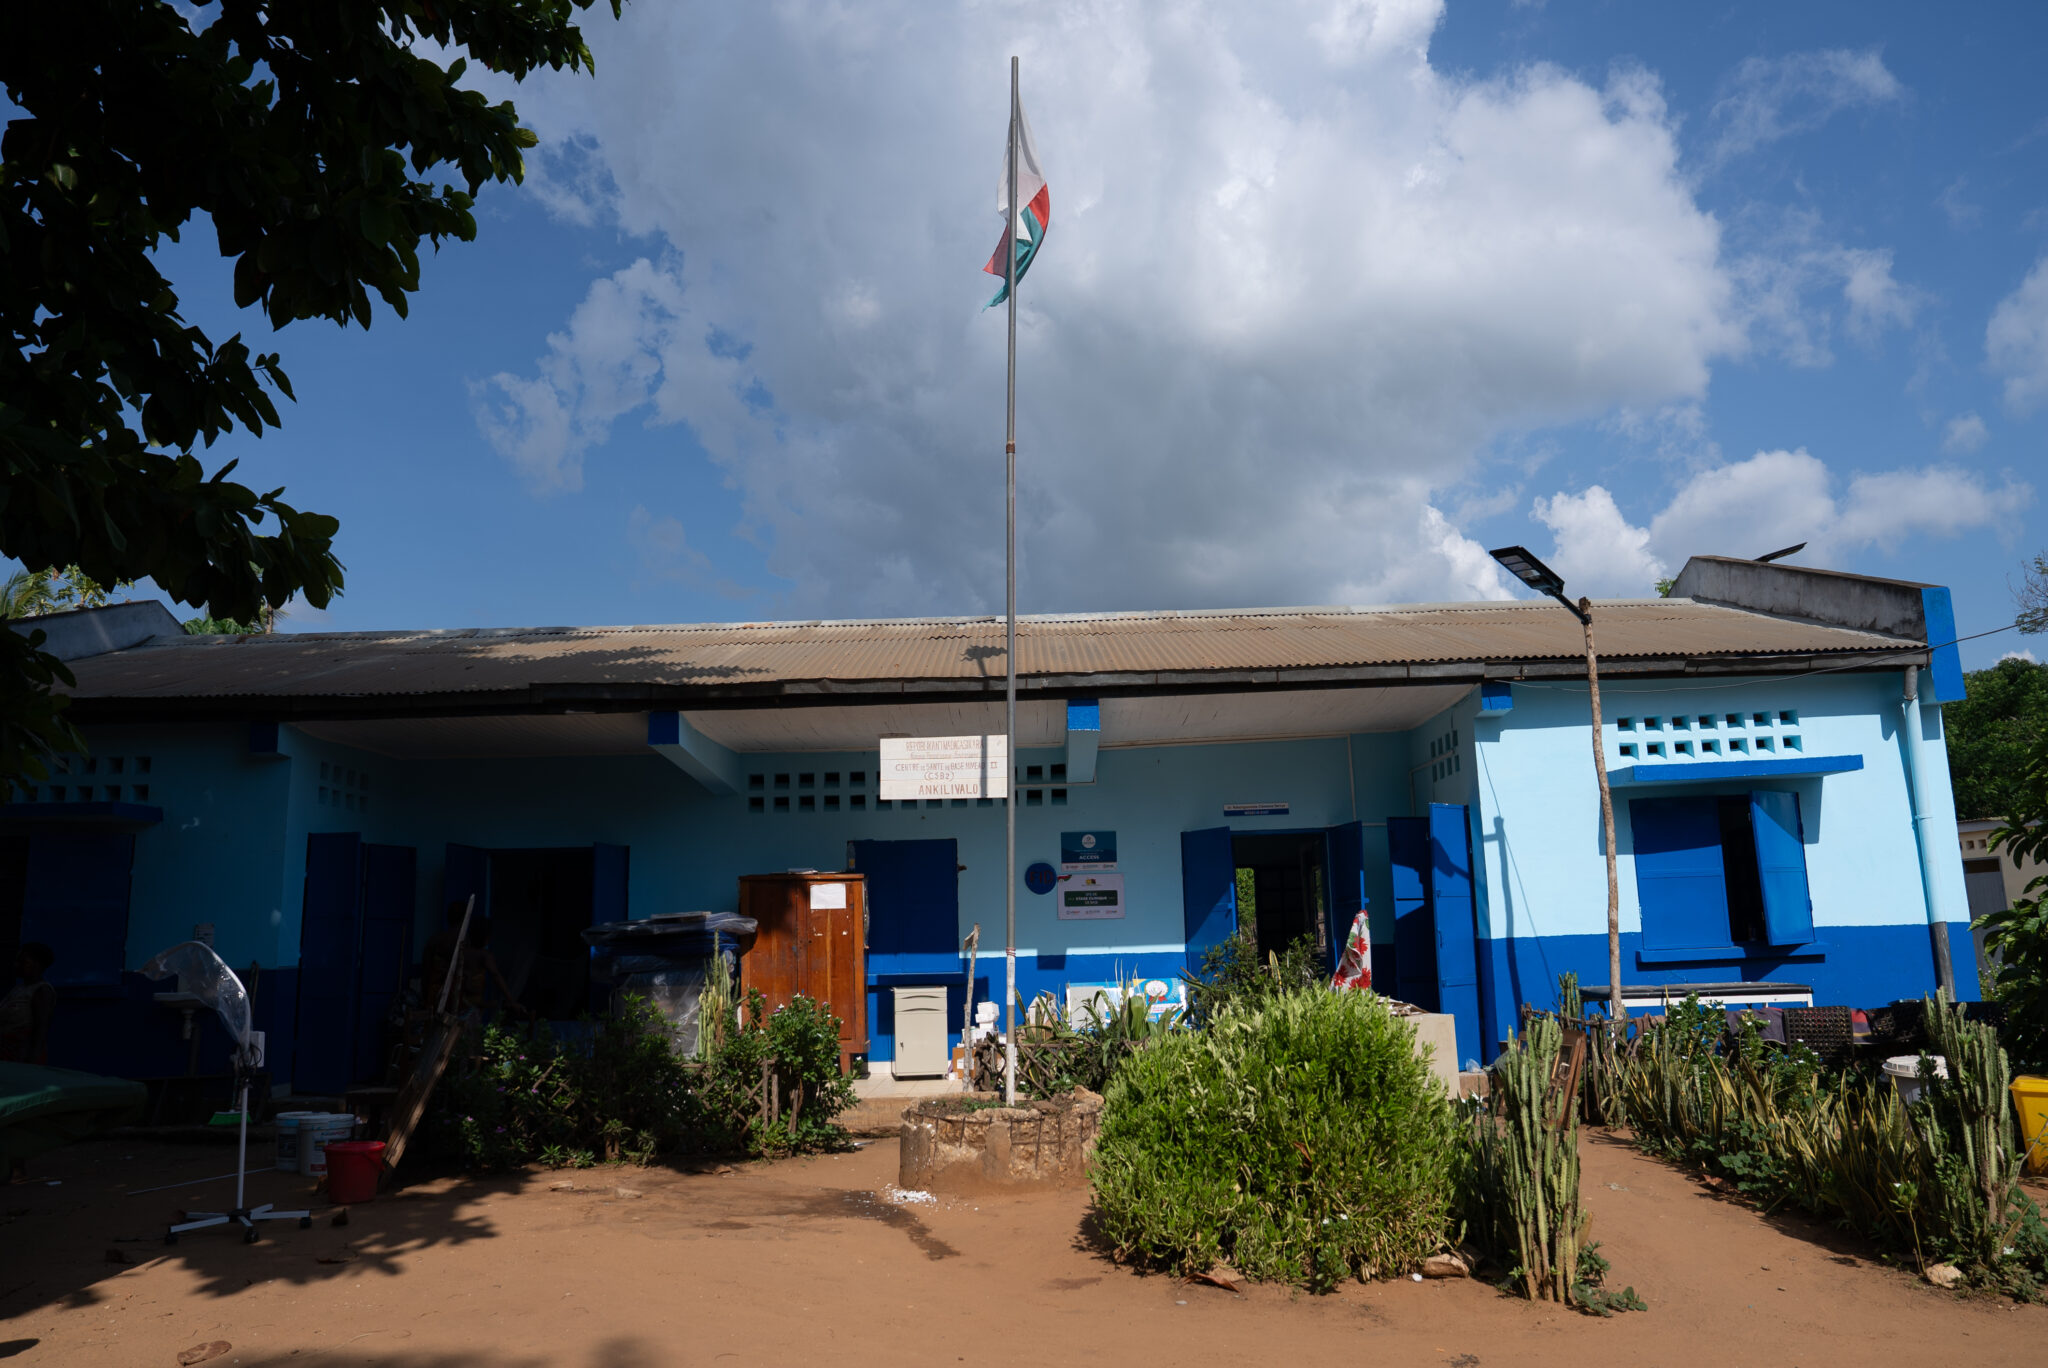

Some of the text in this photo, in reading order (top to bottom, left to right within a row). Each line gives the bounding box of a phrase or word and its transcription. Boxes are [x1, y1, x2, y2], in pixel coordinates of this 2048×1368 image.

[895, 763, 919, 772] CENTRE
[950, 762, 965, 771] BASE
[924, 771, 955, 782] (CSB2)
[919, 784, 978, 795] ANKILIVALO
